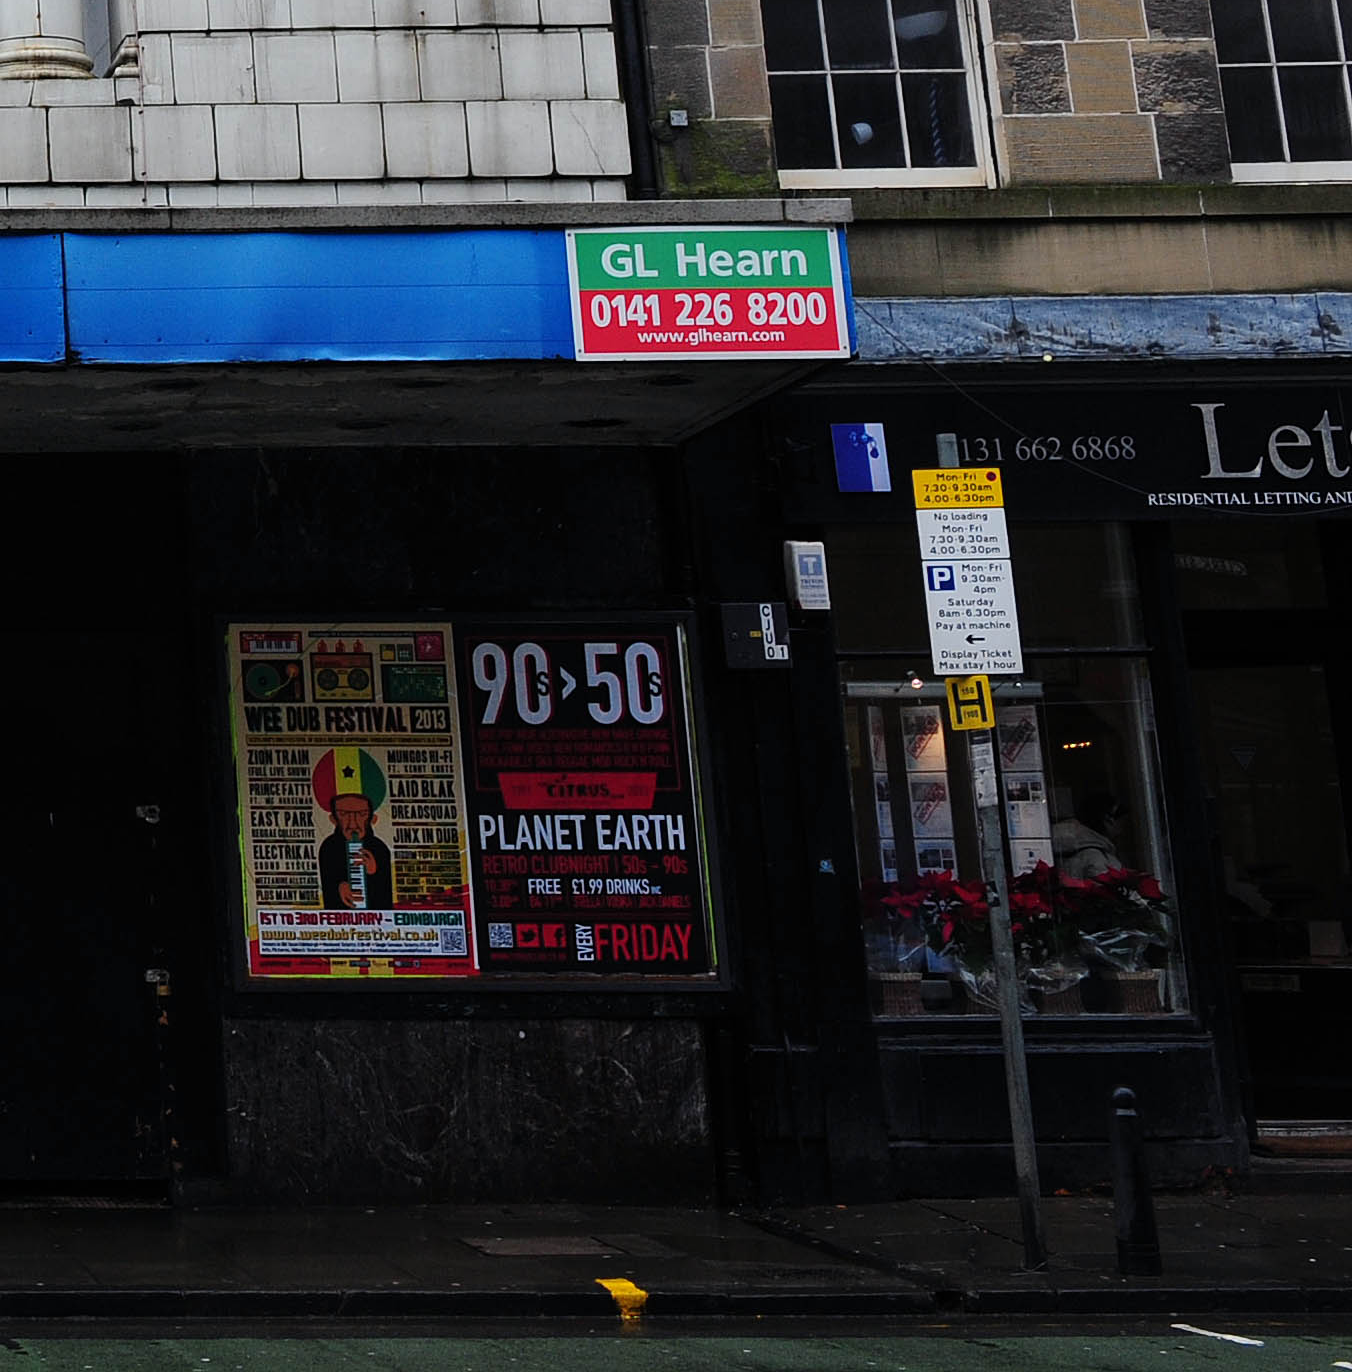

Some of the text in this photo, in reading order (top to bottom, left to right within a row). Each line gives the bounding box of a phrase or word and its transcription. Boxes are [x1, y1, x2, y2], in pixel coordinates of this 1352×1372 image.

[601, 242, 808, 278] GL Hearn
[591, 292, 827, 328] 0141 226 8200
[637, 328, 785, 346] www.glhearn.com
[1015, 436, 1137, 461] 662 6868
[936, 473, 977, 481] Mon-Fri
[923, 483, 993, 493] 7.30-9.30am
[924, 493, 995, 504] 4.00-6.30pm
[1147, 492, 1321, 506] RESIDENTIAL LETTING
[934, 512, 988, 522] No loading
[942, 524, 983, 533] Mon-Fri
[929, 534, 998, 544] 7.30-9.30am
[930, 545, 1001, 555] 4.00-6.30pm
[961, 564, 1003, 572] Mon-Fri
[973, 585, 997, 595] 4pm
[947, 598, 994, 607] Saturday
[939, 609, 1006, 618] 8am-6.30pm
[936, 620, 1012, 631] Pay machine
[941, 650, 1013, 660] Display Ticket
[939, 660, 1017, 670] Max stay hour
[245, 706, 446, 732] WEE DUB FESTIVAL 2013
[247, 749, 310, 765] ZION TRAIN
[387, 750, 453, 763] MUNGOS HI-FI
[249, 783, 311, 796] PRINCE FATTY
[389, 780, 455, 798] LAID BLAK
[250, 811, 314, 827] EAST PARK
[391, 805, 457, 821] DREADSQUAD
[393, 828, 459, 844] JINX DUB
[478, 814, 687, 851] PLANET EARTH
[253, 845, 317, 860] ELECTRIKAL
[531, 854, 609, 875] CLUBNIGHT
[528, 878, 650, 895] FREE £1.99 DRINKS
[319, 912, 463, 926] FEBRUARY EDINBURGH
[575, 923, 595, 961] EVERY
[596, 923, 693, 962] FRIDAY
